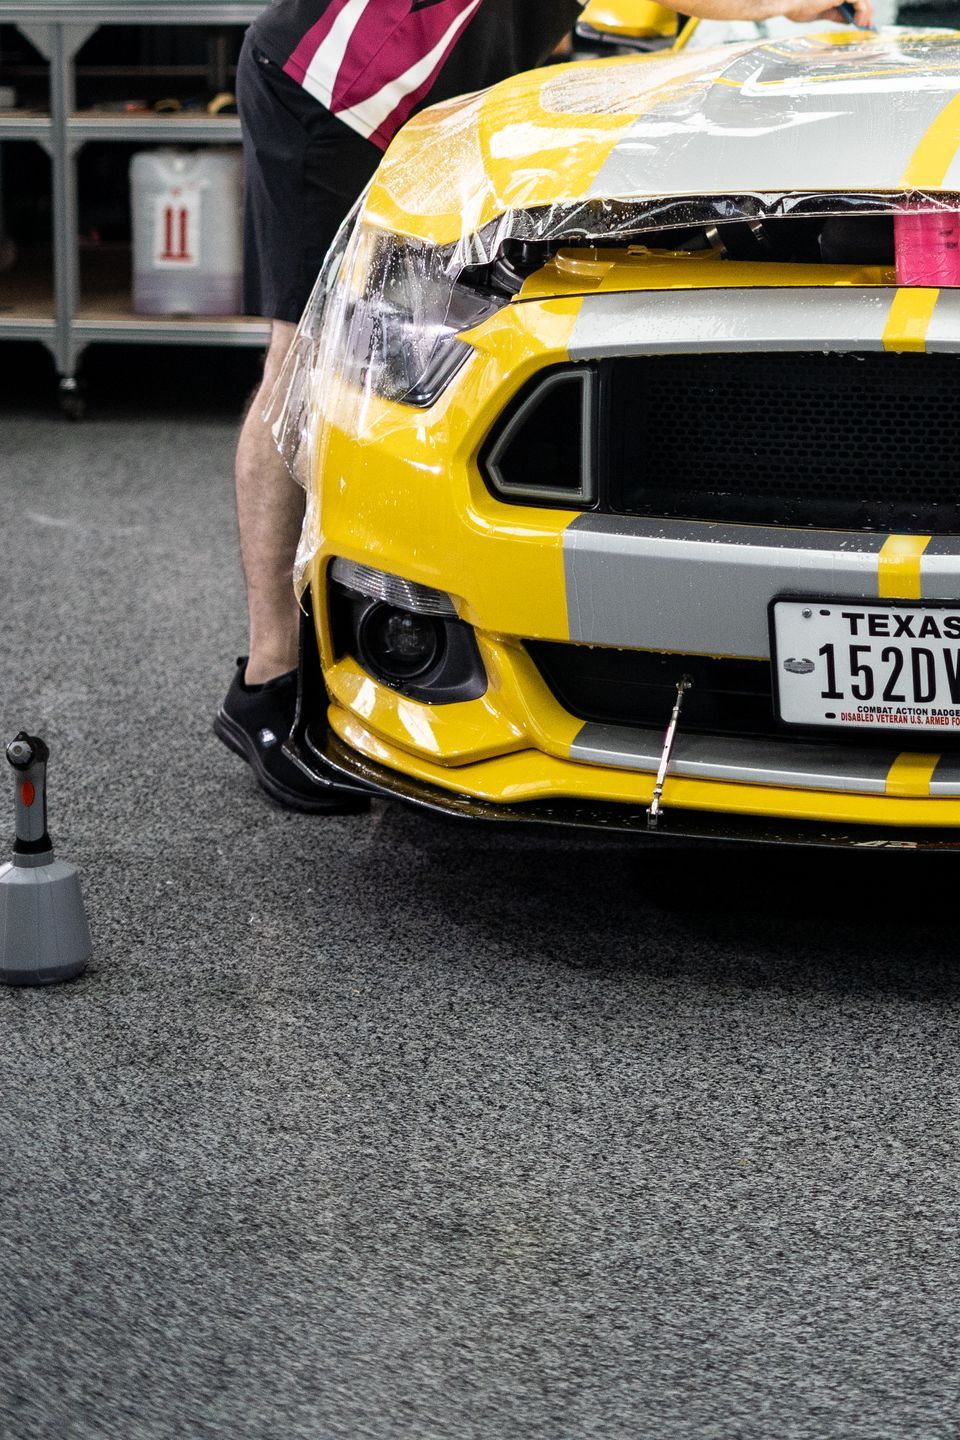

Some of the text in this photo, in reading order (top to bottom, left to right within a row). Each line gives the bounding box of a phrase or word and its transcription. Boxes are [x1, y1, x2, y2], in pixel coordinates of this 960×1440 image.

[857, 706, 960, 717] COMBAT ACTION BADGE
[840, 712, 874, 722] DISABLED
[877, 714, 908, 724] VETERAN
[911, 715, 923, 725] U.S.
[925, 716, 949, 726] ARMED
